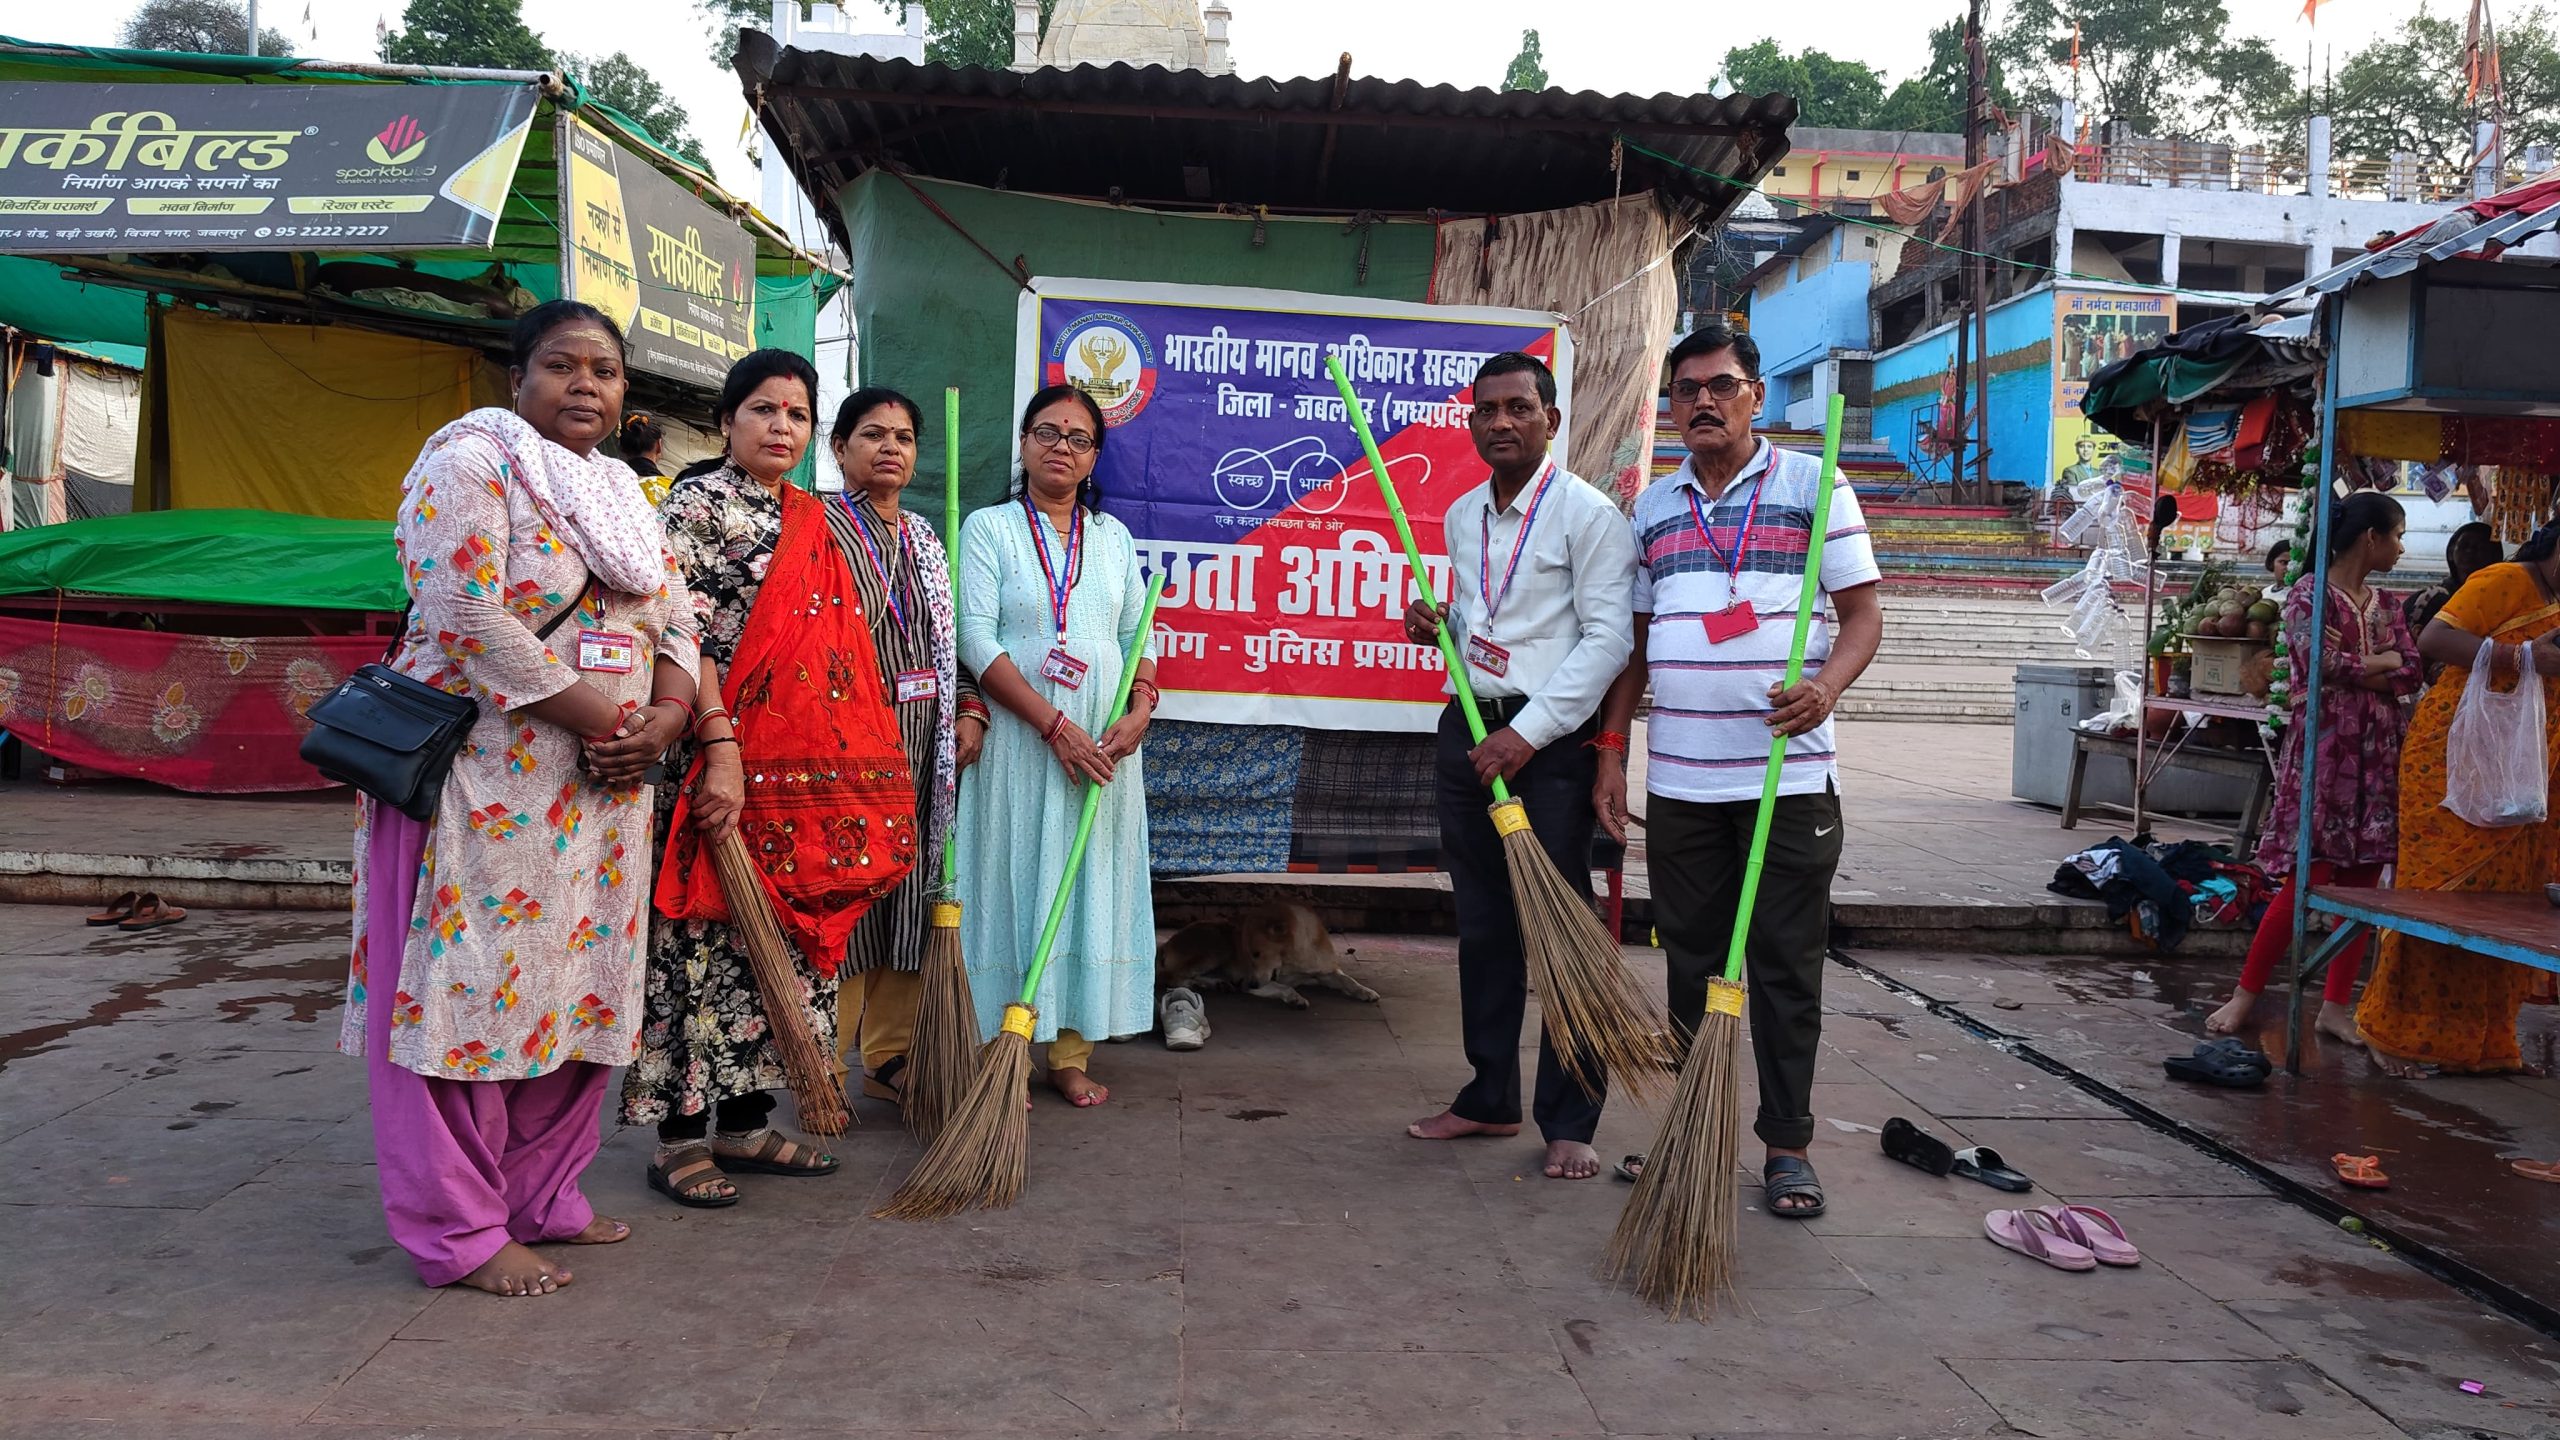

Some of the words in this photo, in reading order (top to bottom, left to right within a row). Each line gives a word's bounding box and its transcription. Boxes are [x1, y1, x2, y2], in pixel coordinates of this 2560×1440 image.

[61, 173, 127, 190] निर्माण
[131, 174, 192, 191] आपके
[197, 174, 251, 191] सपनों
[253, 177, 282, 190] का
[0, 200, 51, 211] नियरिंग
[52, 200, 98, 211] परामर्श
[159, 203, 192, 212] भवन
[192, 201, 236, 212] निर्माण
[321, 199, 357, 210] रियल
[361, 199, 395, 210] एस्टेट
[586, 200, 610, 240] नक्शे
[612, 206, 621, 245] से
[26, 227, 49, 239] रोड,
[56, 227, 82, 240] बड़ी
[124, 227, 162, 238] विजय
[197, 229, 247, 239] जबलपुर
[274, 226, 297, 237] 95
[299, 226, 342, 237] 2222
[345, 225, 389, 237] 7277
[581, 235, 612, 284] निर्माण
[613, 260, 629, 292] तक
[646, 224, 723, 307] स्पार्कबिल्ड
[2086, 296, 2112, 311] नर्मदा
[2115, 298, 2161, 312] महाआरती
[1071, 314, 1094, 329] MANAV
[1095, 313, 1124, 324] ADHIKAR
[1165, 326, 1250, 375] भारतीय
[1255, 340, 1319, 379] मानव
[1217, 383, 1273, 418] जिला
[1227, 473, 1264, 488] स्वच्छ
[1299, 477, 1334, 492] भारत
[1214, 515, 1234, 528] एक
[1265, 517, 1304, 529] स्वच्छता
[1307, 517, 1321, 531] की
[1325, 518, 1345, 531] ओर
[1244, 629, 1344, 673] पुलिस
